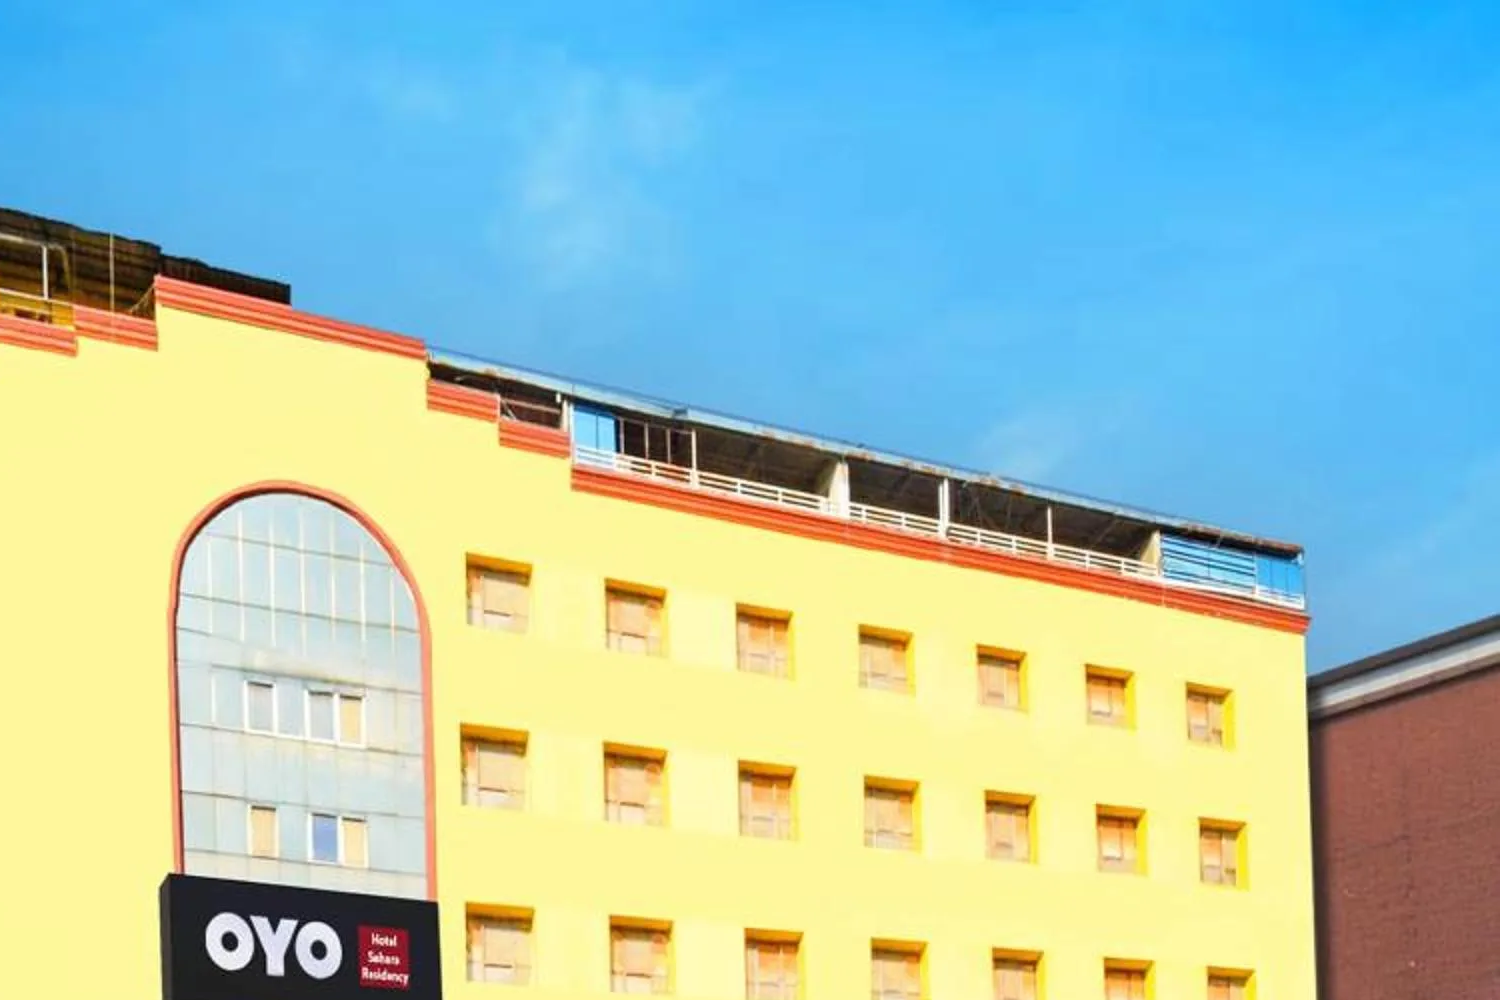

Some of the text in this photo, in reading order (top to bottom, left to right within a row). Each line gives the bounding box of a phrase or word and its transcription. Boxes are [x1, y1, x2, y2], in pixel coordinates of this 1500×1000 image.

[205, 911, 343, 980] OYO
[371, 932, 397, 947] Hotel
[361, 967, 410, 986] Residency
